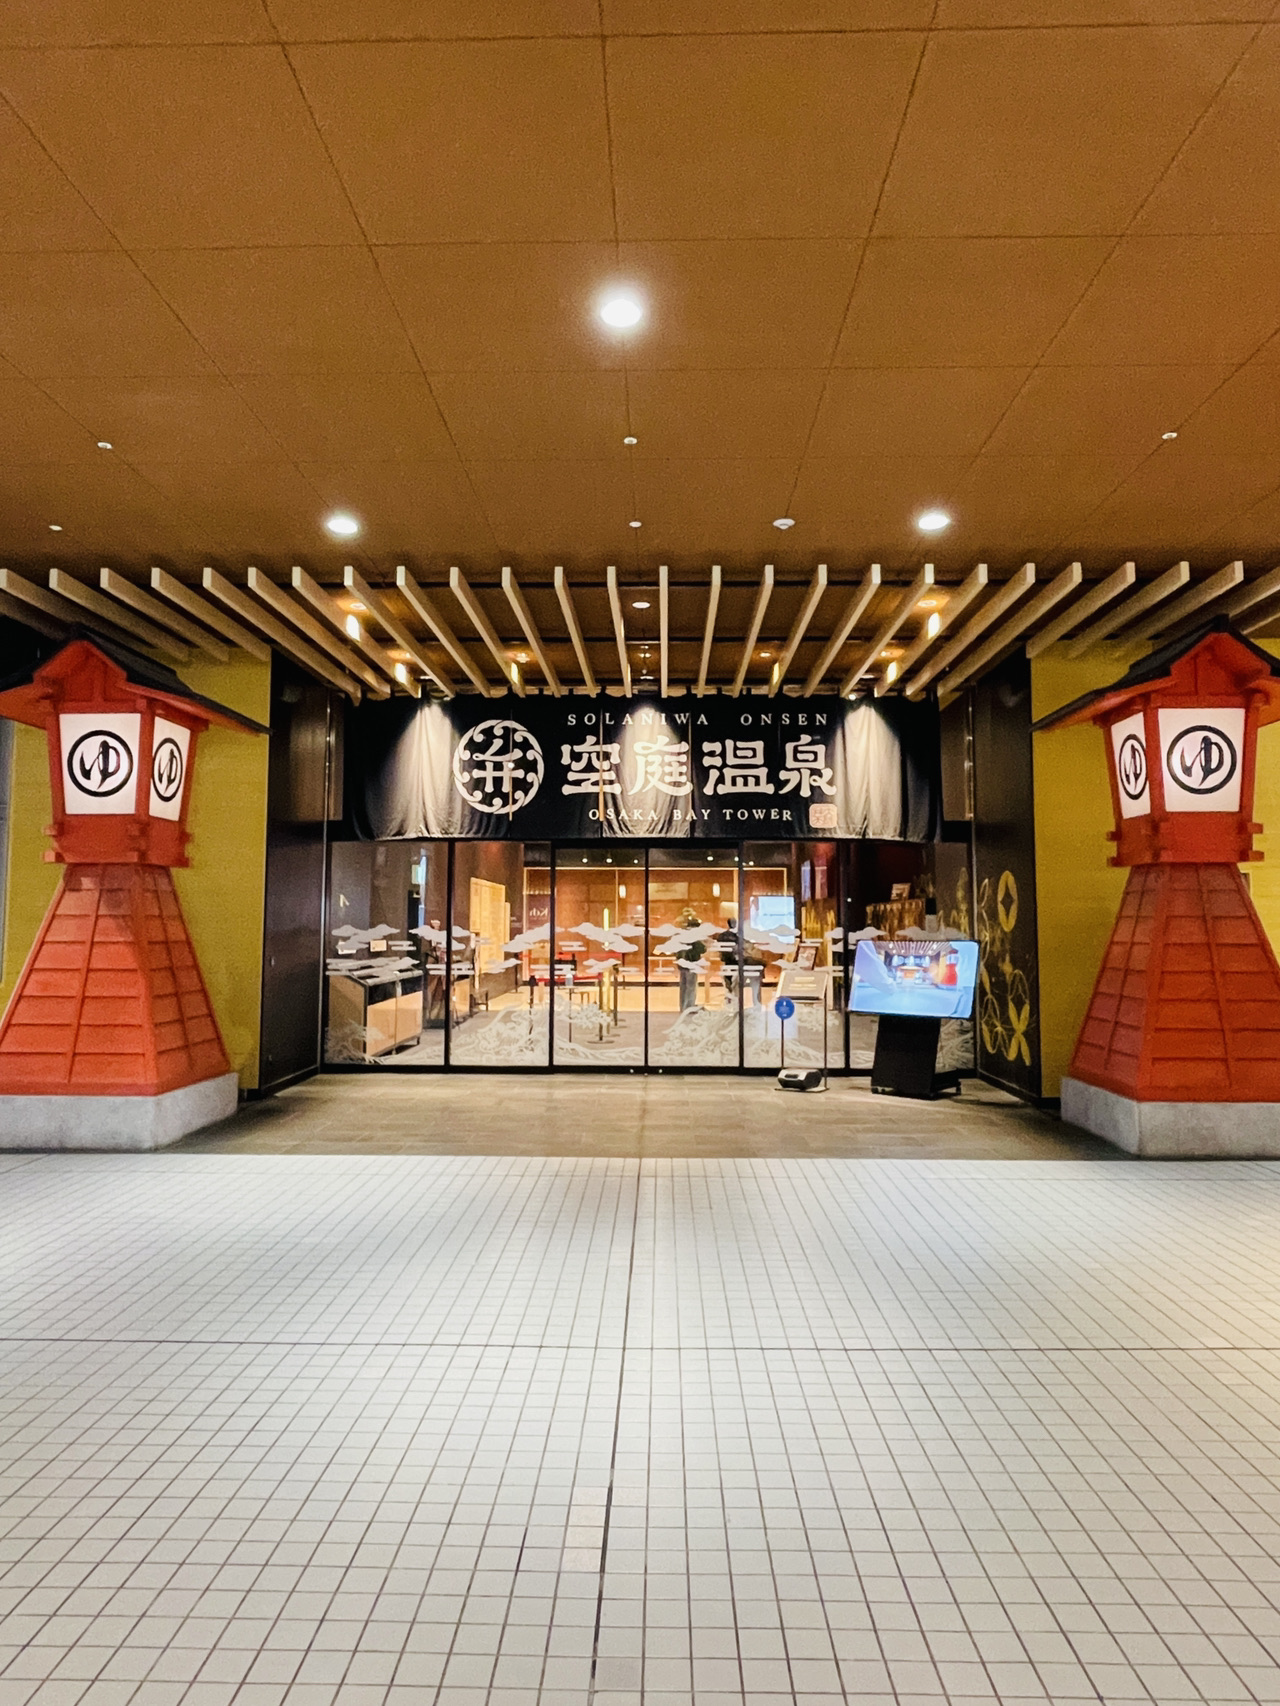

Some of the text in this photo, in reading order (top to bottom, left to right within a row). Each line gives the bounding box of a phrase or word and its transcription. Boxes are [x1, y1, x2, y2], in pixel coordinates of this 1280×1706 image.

[567, 712, 828, 726] SOLANIWA ONSEN
[79, 739, 121, 790] ゆ
[157, 748, 178, 794] ゆ
[560, 734, 838, 798] 空庭温泉
[1179, 735, 1224, 787] ゆ
[588, 808, 793, 821] OSAKA BAY TOWER
